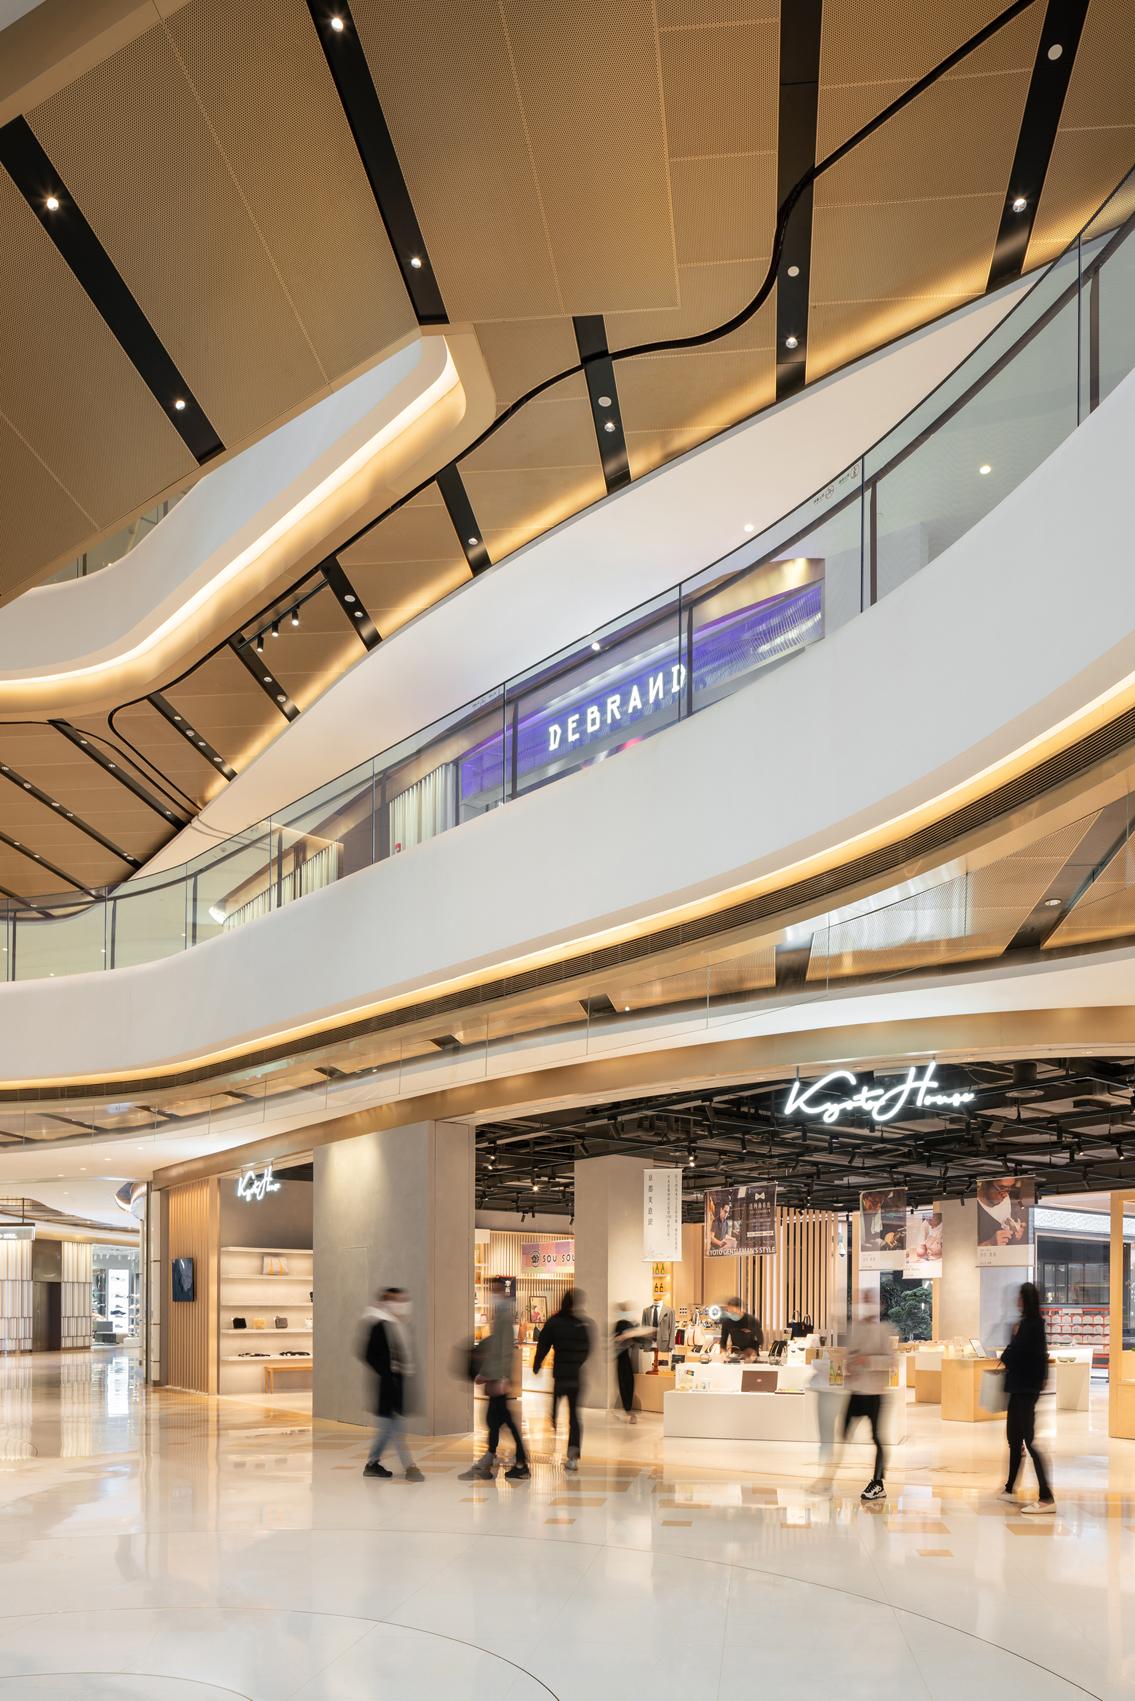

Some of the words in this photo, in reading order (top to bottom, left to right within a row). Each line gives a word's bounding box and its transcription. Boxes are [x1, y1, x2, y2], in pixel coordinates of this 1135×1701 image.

[784, 1070, 885, 1123] Kyoto
[872, 1061, 975, 1121] House
[759, 1246, 776, 1254] STYLE
[542, 1253, 557, 1263] SOU
